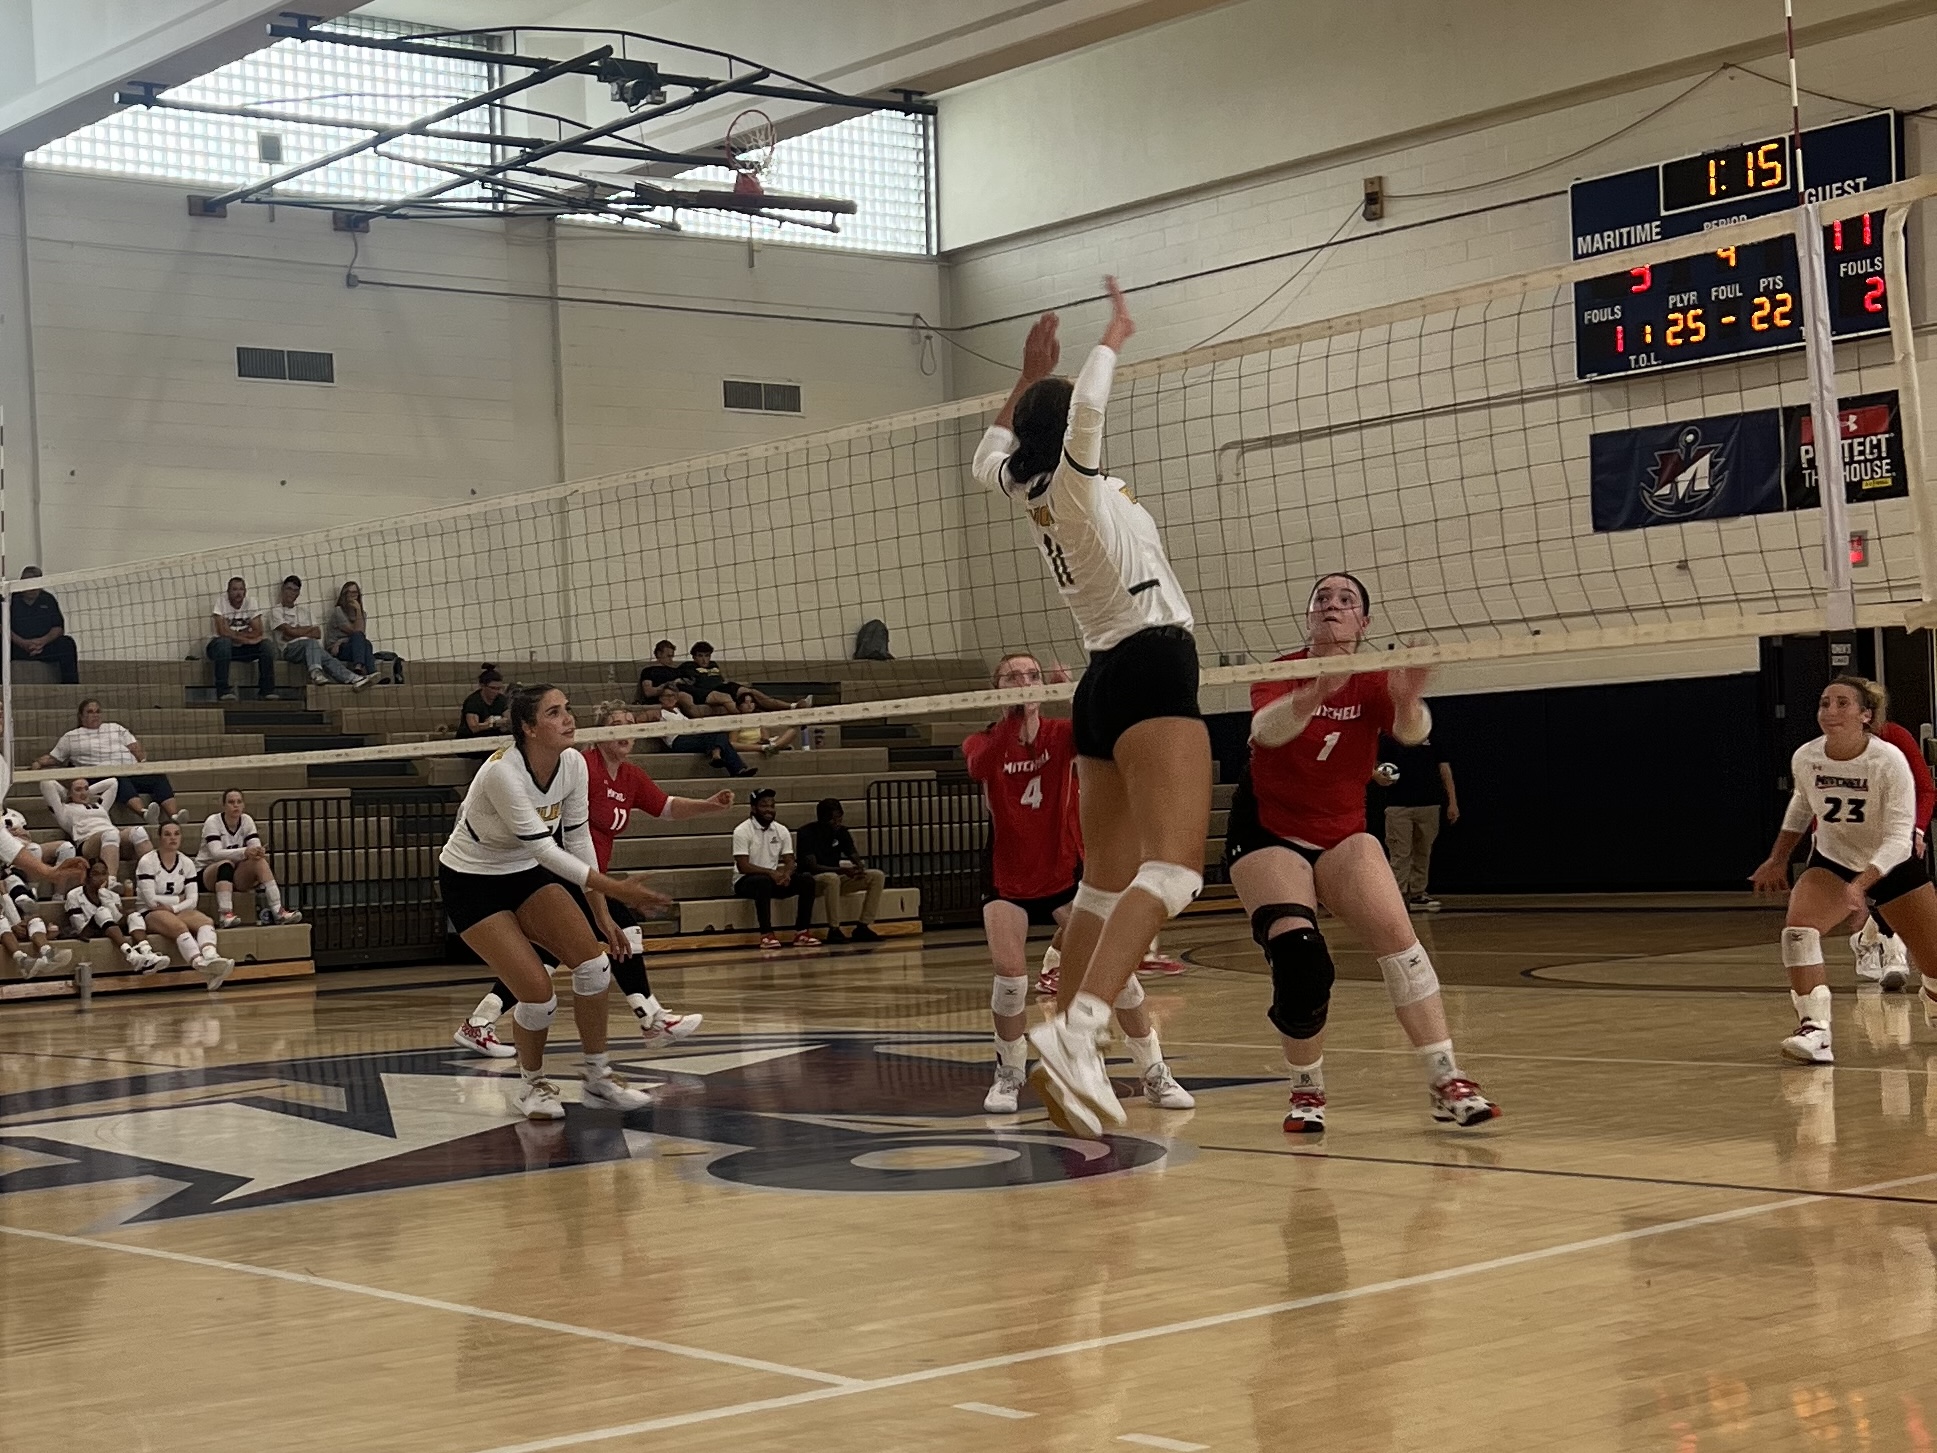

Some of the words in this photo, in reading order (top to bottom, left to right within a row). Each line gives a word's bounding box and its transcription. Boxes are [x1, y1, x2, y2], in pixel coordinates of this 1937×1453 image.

[1709, 143, 1782, 196] 1:15
[1804, 177, 1867, 204] GUEST
[1577, 220, 1662, 255] MARITIME
[1840, 256, 1883, 278] FOULS
[1668, 291, 1699, 309] PLYR
[1711, 283, 1743, 301] FOUL
[1759, 276, 1784, 291] PTS
[1864, 276, 1885, 312] 2
[1584, 305, 1622, 324] FOULS
[1666, 308, 1706, 346] 25
[1751, 293, 1792, 331] 22
[1800, 434, 1890, 468] PTECT
[1316, 732, 1341, 761] 1
[1021, 775, 1043, 810] 4
[1823, 796, 1866, 823] 23
[166, 882, 175, 895] 5
